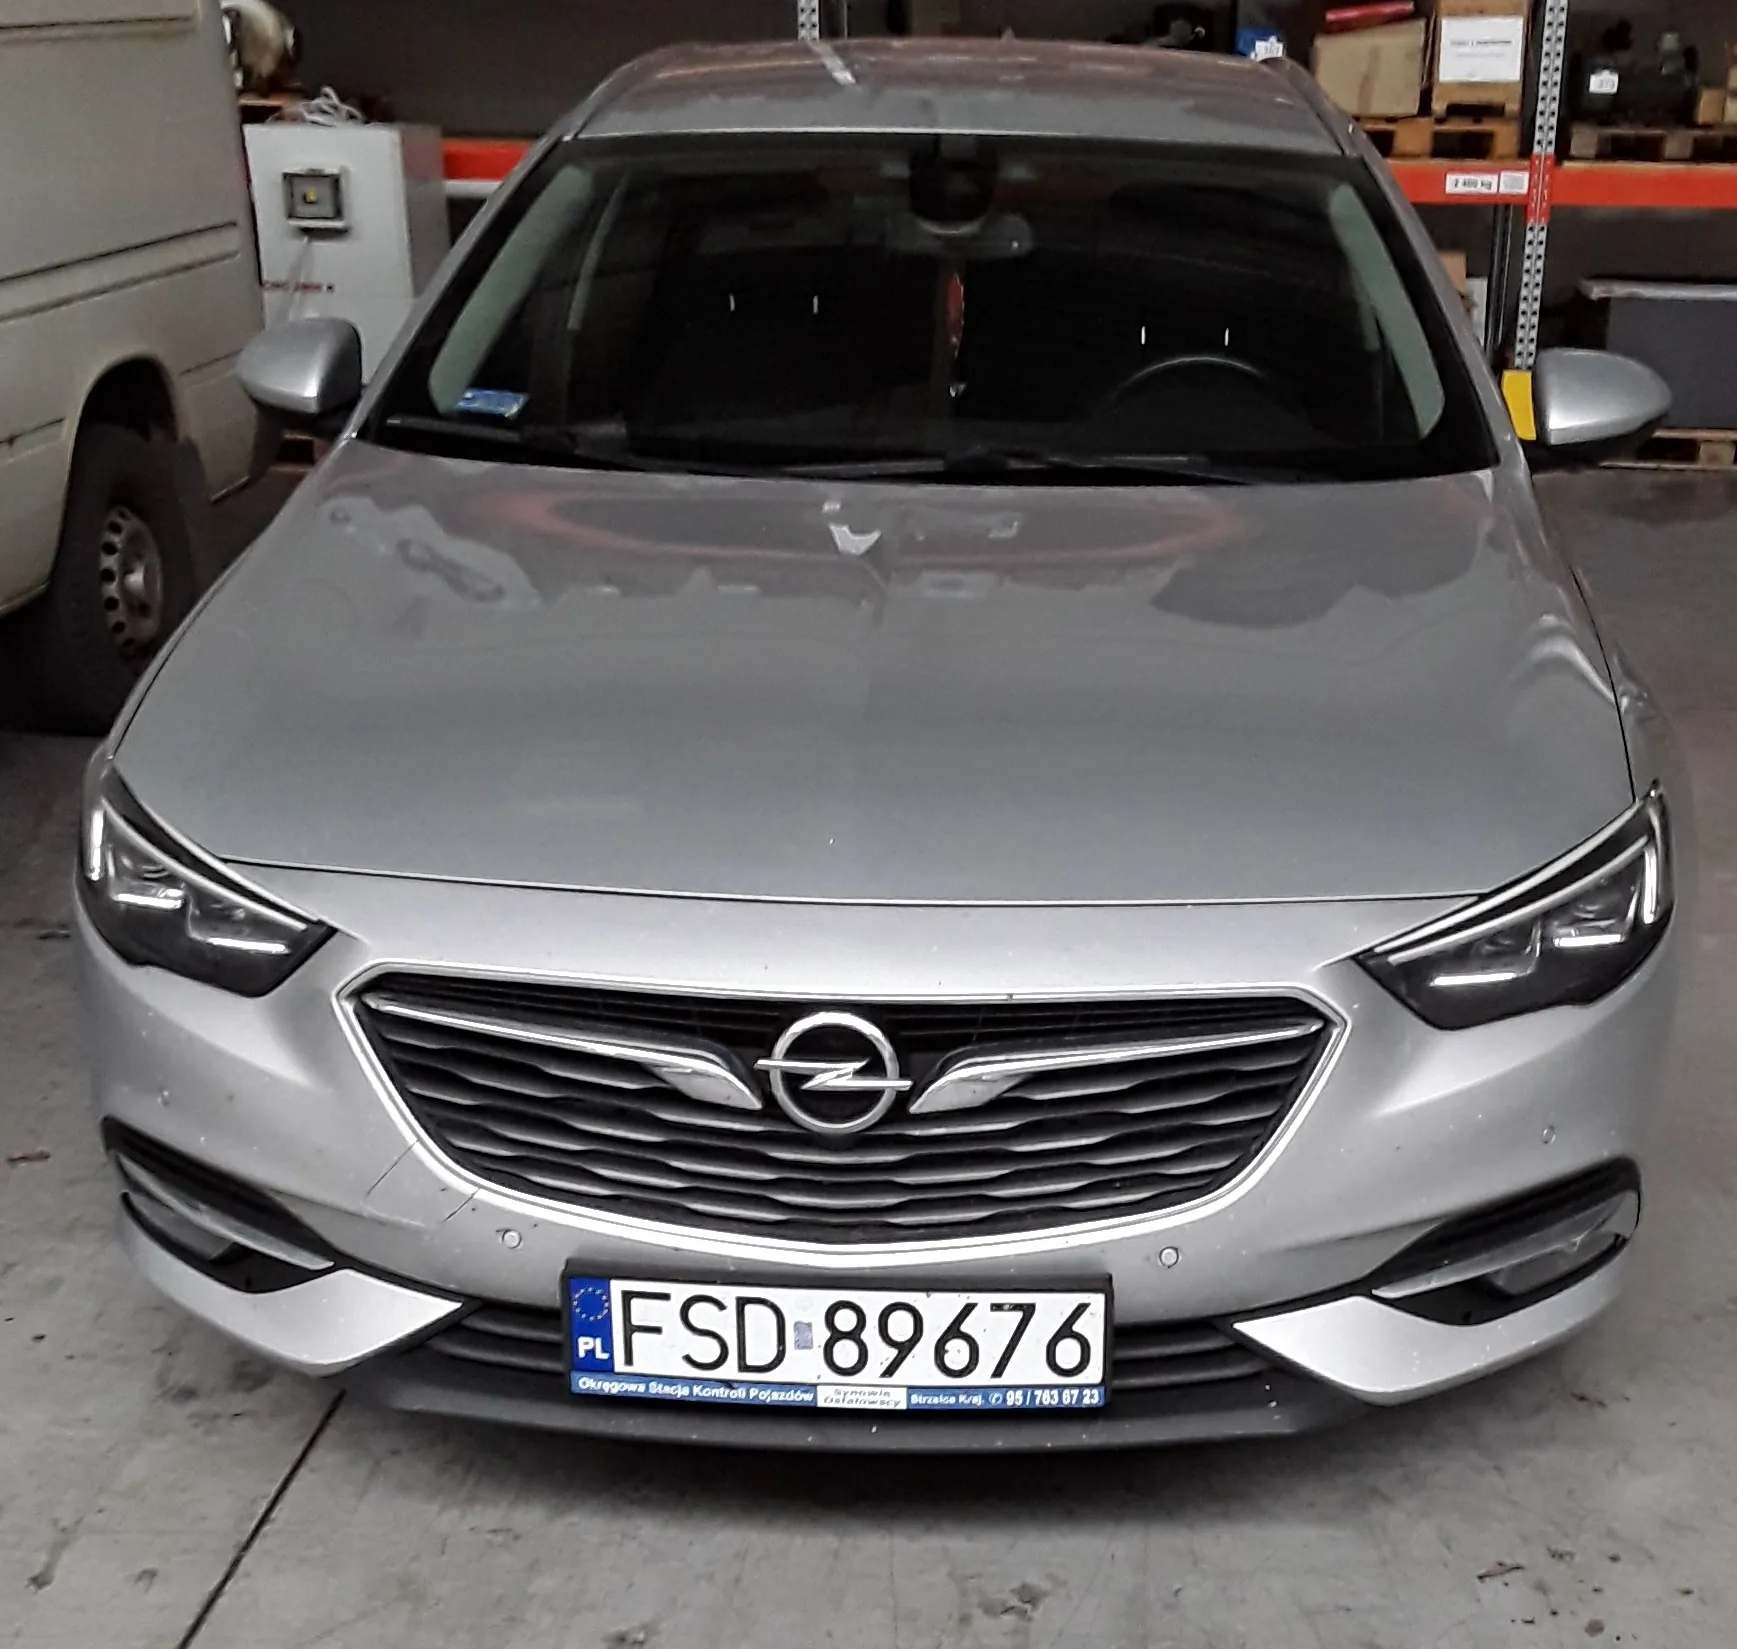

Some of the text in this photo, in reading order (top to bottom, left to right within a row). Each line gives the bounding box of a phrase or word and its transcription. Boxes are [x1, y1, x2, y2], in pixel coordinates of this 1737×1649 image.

[620, 1289, 1092, 1379] FSD 89676
[577, 1336, 611, 1360] PL
[577, 1376, 815, 1404] Okręgowa Stacja Kontroli Pojazdów
[1006, 1389, 1024, 1406] 95
[1082, 1387, 1100, 1405] 23
